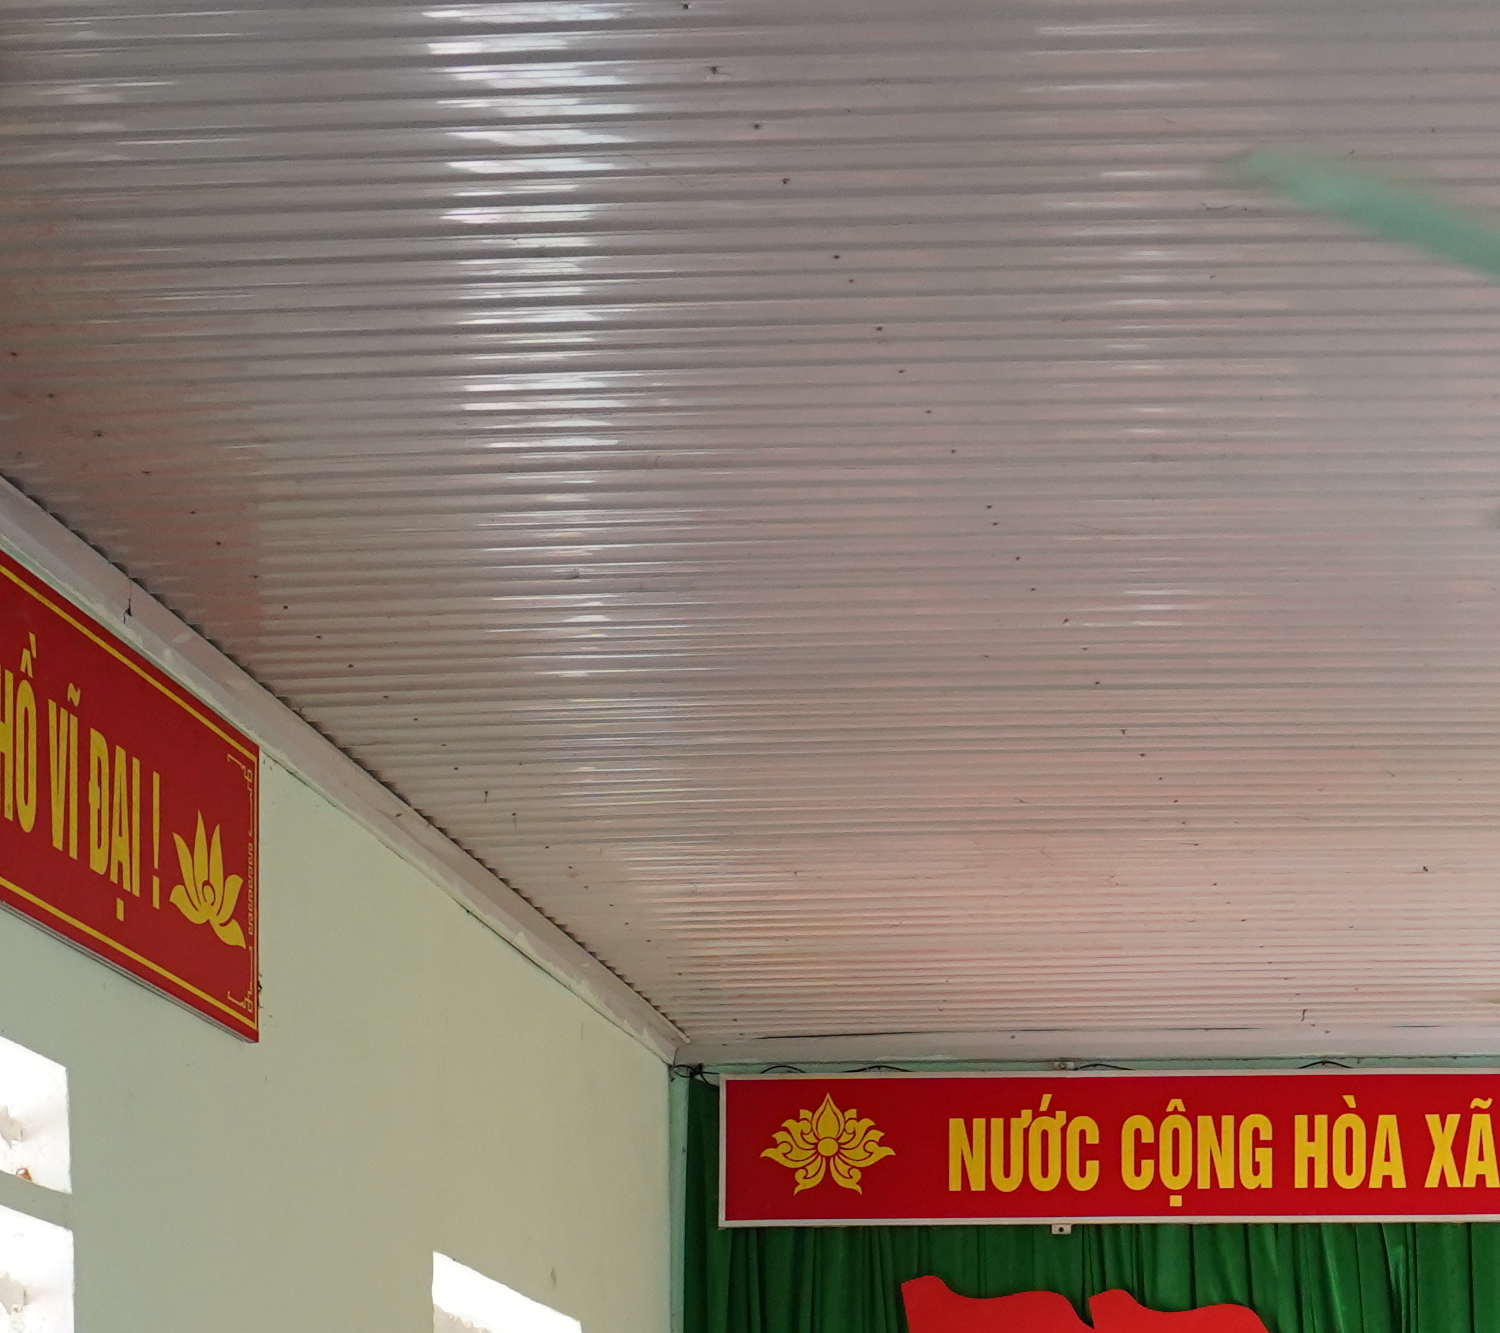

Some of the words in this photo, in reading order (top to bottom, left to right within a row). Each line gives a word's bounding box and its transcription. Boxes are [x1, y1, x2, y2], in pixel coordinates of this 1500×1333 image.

[47, 683, 81, 860] VĨ
[88, 727, 141, 922] ĐẠI
[949, 1093, 1100, 1193] NƯỚC
[1121, 1098, 1273, 1207] CỘNG
[1294, 1094, 1407, 1190] HÒA
[1424, 1097, 1500, 1188] XÃ
